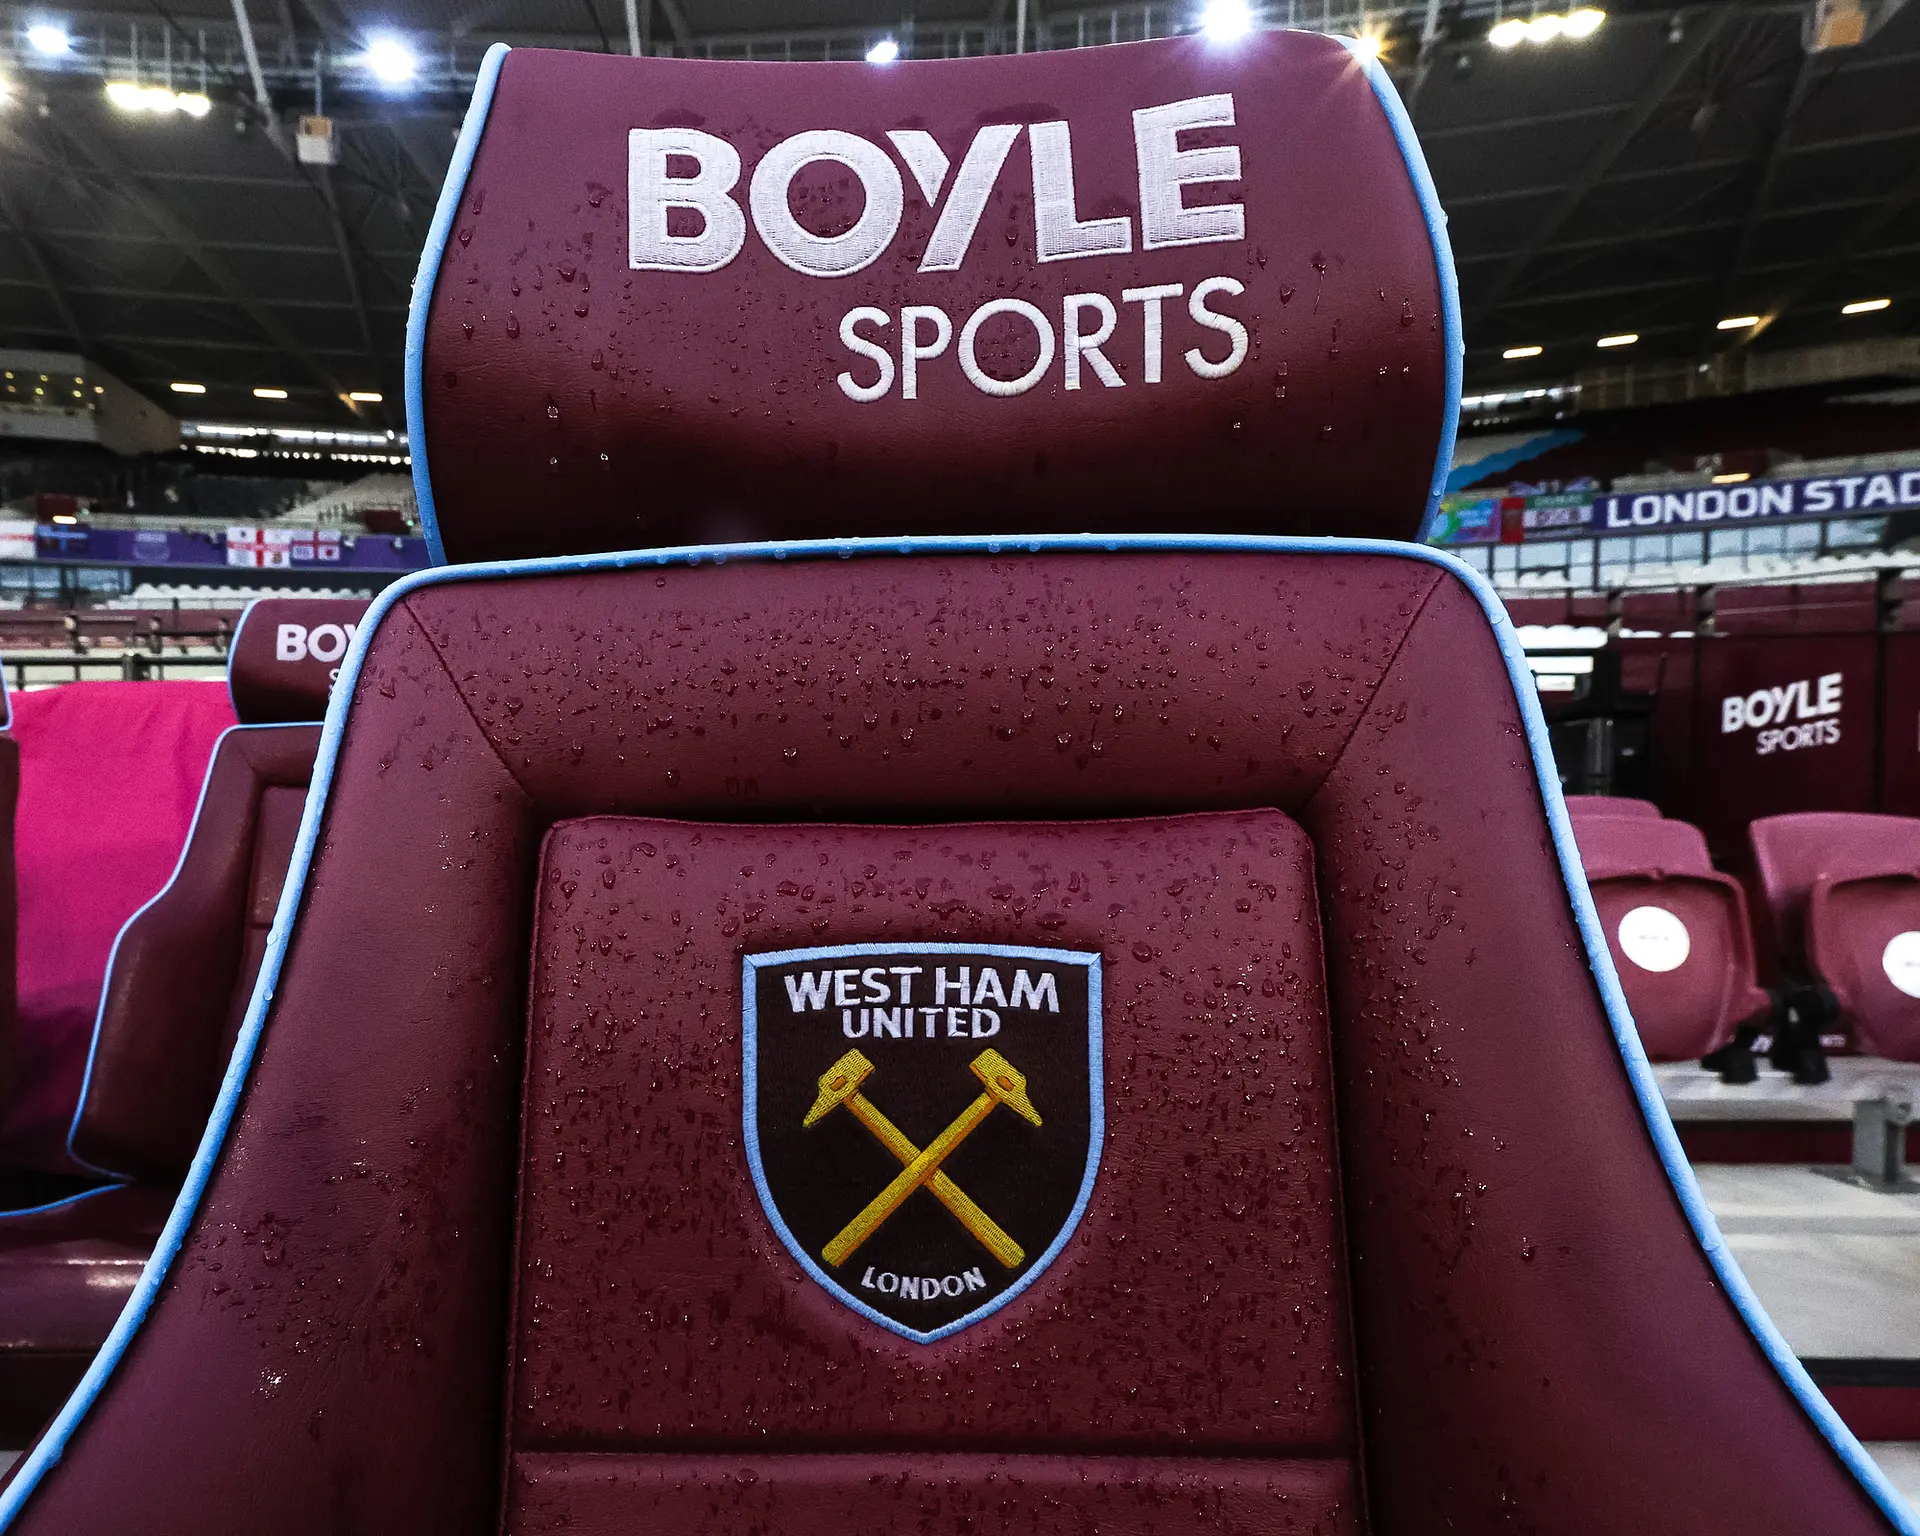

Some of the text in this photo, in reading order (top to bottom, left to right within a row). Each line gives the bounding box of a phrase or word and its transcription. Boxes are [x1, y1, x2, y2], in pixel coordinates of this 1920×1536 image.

[627, 92, 1247, 279] BOYLE
[836, 275, 1249, 403] SPORTS
[1606, 484, 1796, 529] LONDON
[1721, 671, 1843, 733] BOYLE
[1755, 718, 1841, 755] SPORTS
[784, 966, 1060, 1013] WEST HAM
[842, 1007, 1001, 1039] UNITED
[861, 1266, 987, 1300] LONDON
